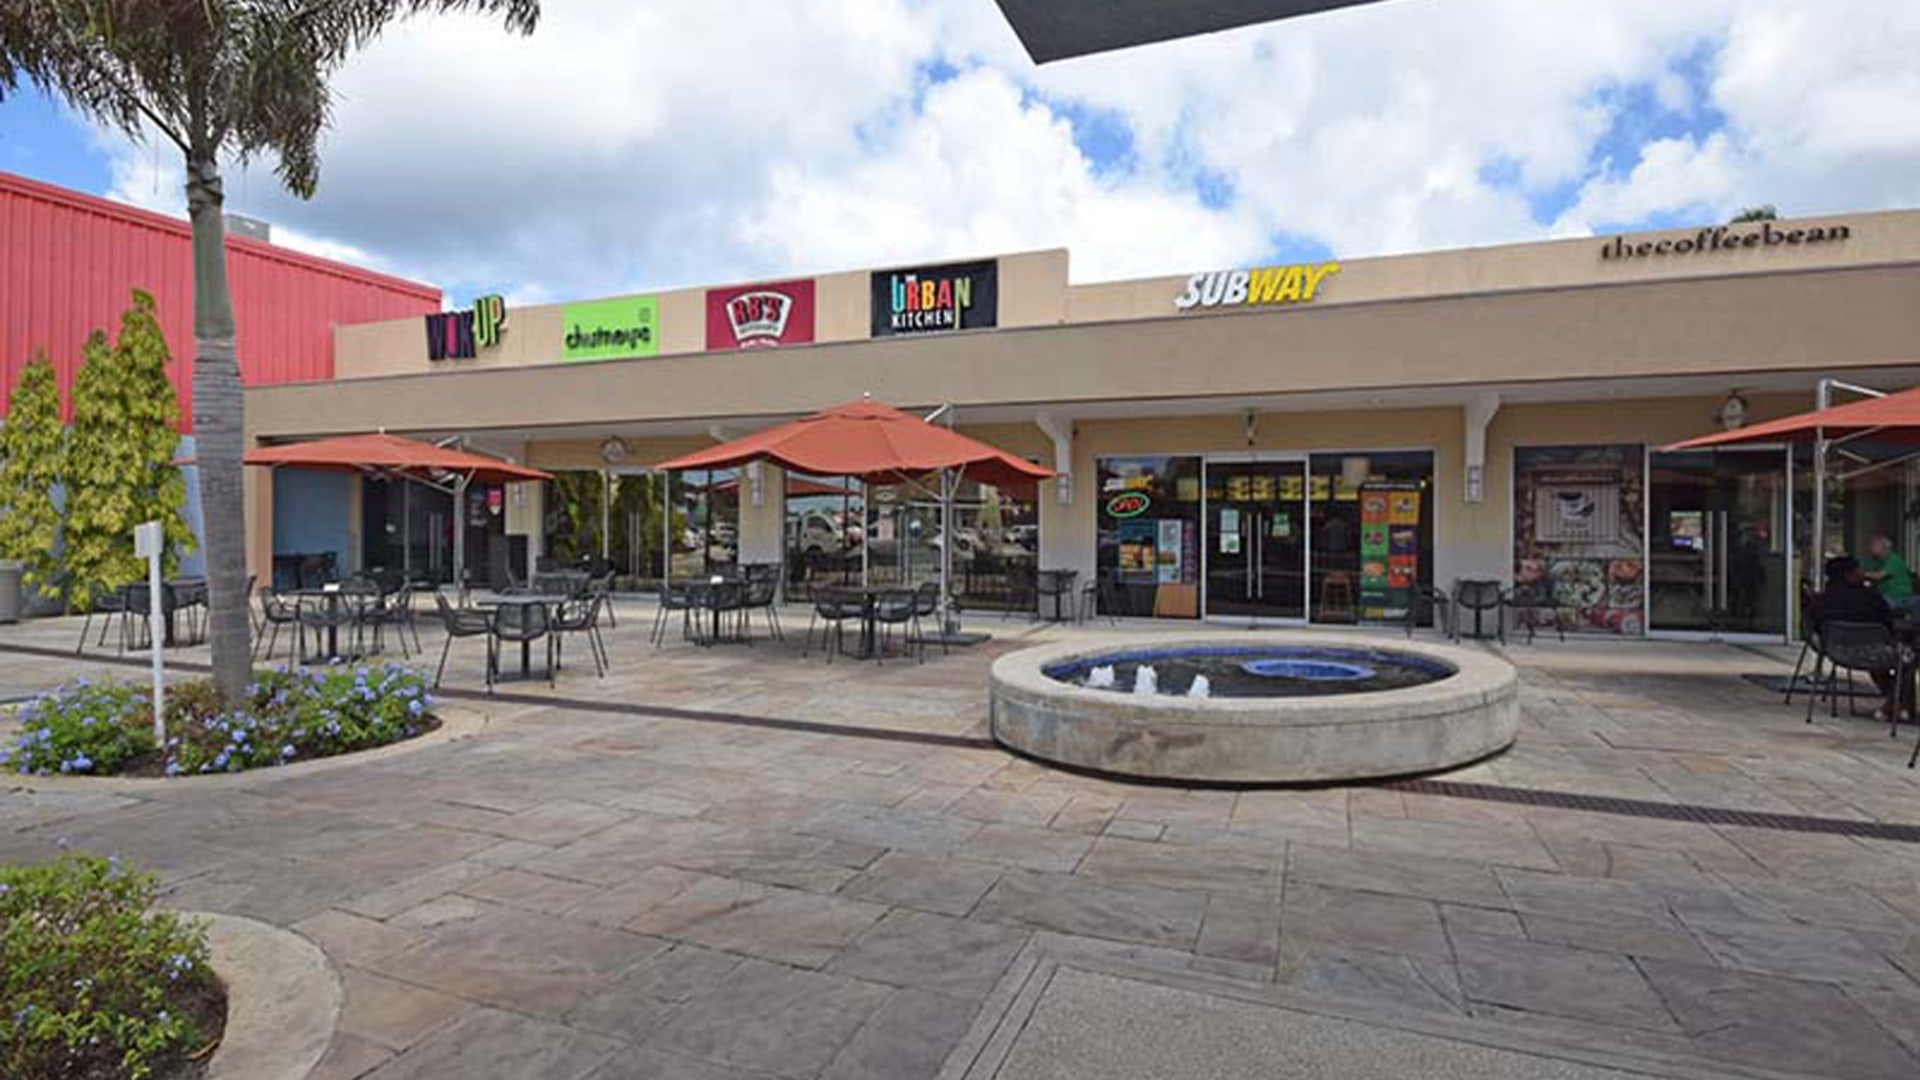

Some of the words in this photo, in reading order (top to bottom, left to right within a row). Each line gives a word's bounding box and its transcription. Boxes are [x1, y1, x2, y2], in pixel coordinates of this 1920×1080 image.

[1602, 222, 1851, 260] thecoffeebean
[891, 274, 971, 330] URBAN
[1174, 261, 1341, 309] SUBWAY
[891, 309, 954, 328] KITCHEN
